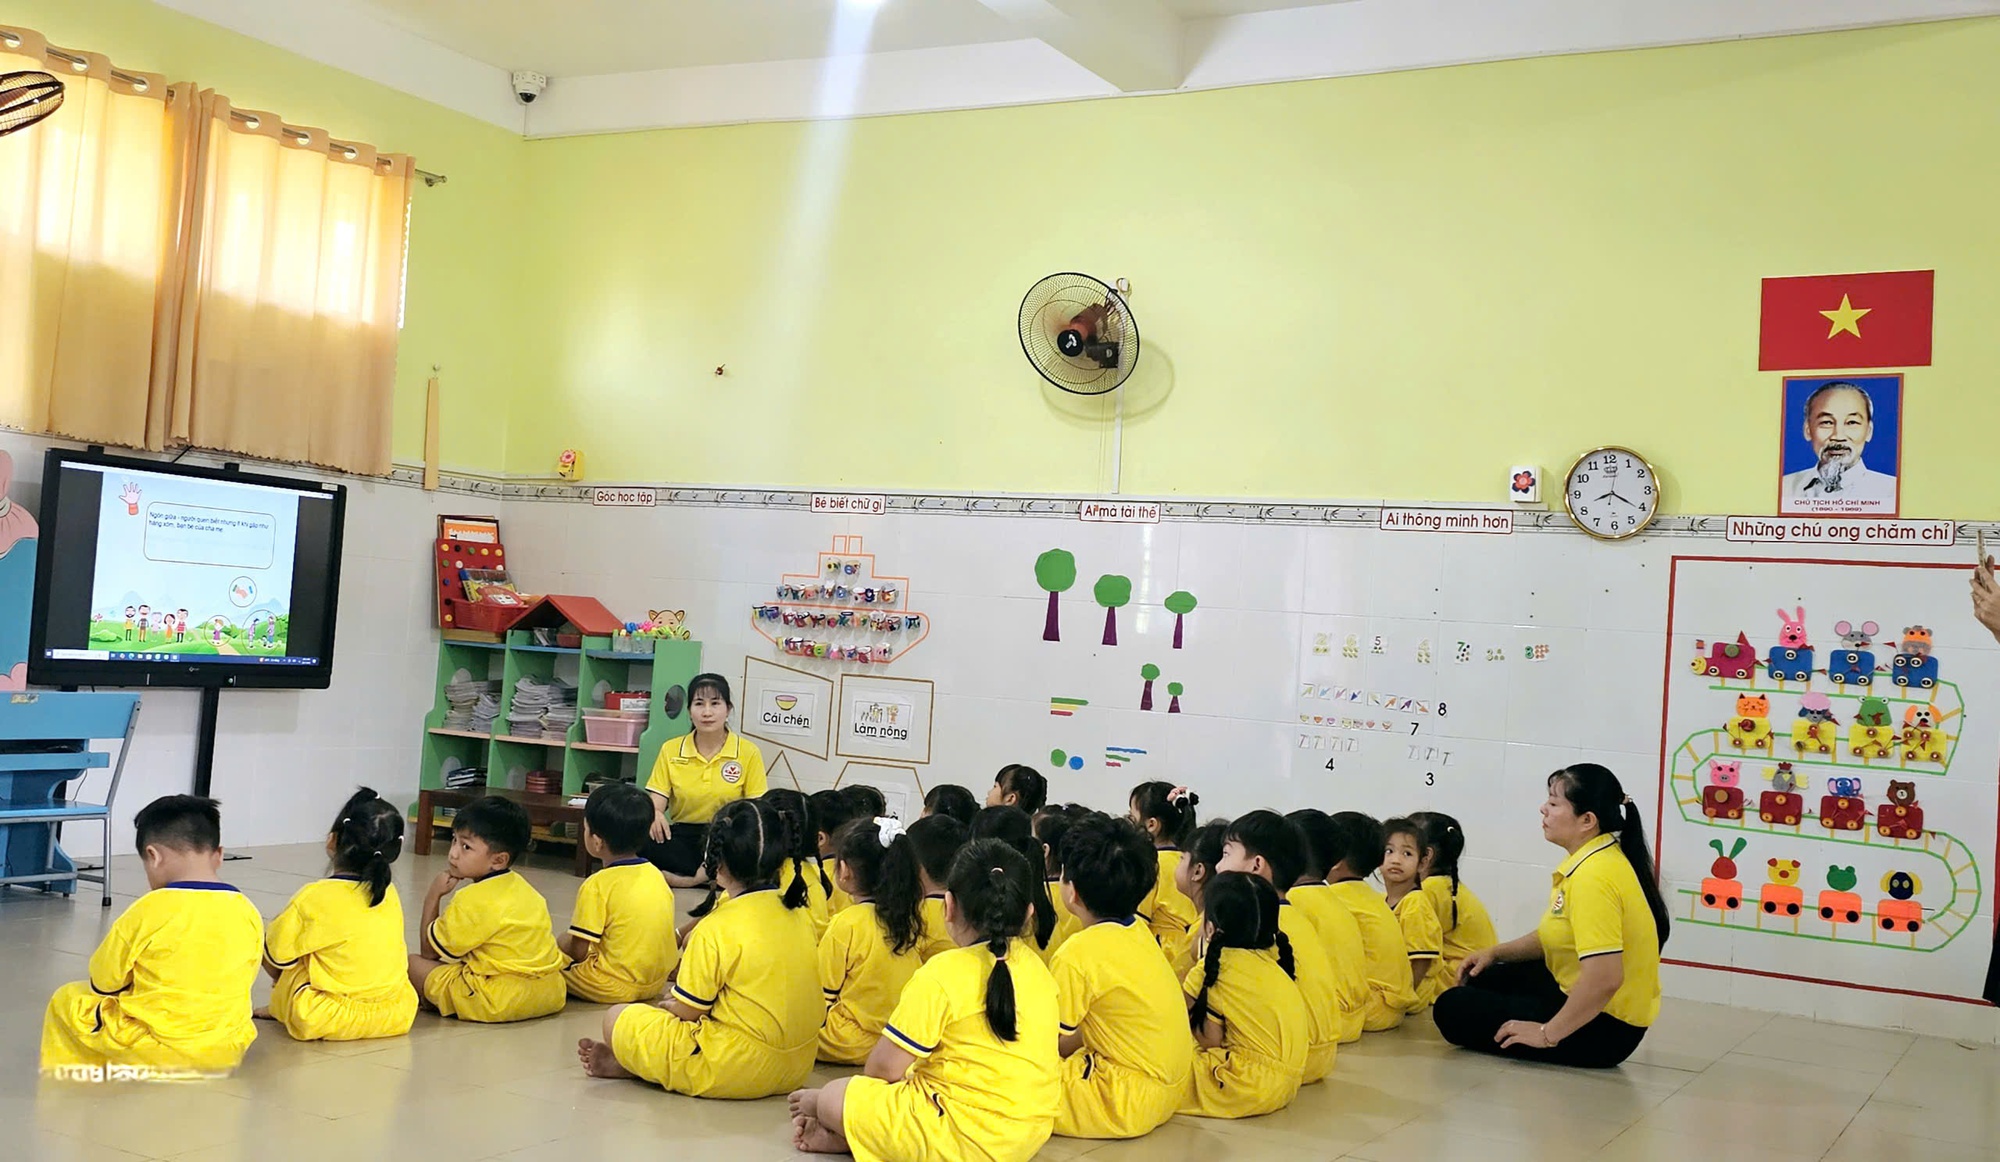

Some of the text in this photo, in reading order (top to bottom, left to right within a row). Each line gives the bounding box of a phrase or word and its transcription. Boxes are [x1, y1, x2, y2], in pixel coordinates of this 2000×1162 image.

[1603, 454, 1617, 464] 12
[1625, 459, 1632, 468] 1
[1588, 461, 1599, 471] 11
[1577, 474, 1589, 483] 10
[1637, 469, 1645, 478] 2
[1573, 490, 1581, 499] 9
[1644, 485, 1652, 495] 3
[597, 490, 653, 504] Góc học tập
[815, 496, 827, 508] Bé
[830, 496, 848, 508] biết
[851, 497, 870, 509] chữ
[1638, 502, 1647, 511] 4
[1099, 504, 1117, 517] mà
[1121, 504, 1135, 518] tài
[1139, 504, 1158, 518] thế
[1580, 506, 1588, 515] 8
[1386, 513, 1509, 529] Ai thông minh hơn
[1593, 517, 1601, 527] 7
[1627, 515, 1636, 525] 5
[1611, 521, 1619, 531] 6
[1732, 520, 1949, 541] Những chú ong chăm chỉ
[1374, 636, 1381, 646] 5
[1457, 641, 1465, 651] 7
[1437, 702, 1447, 716] 8
[763, 711, 809, 727] Cái chén
[854, 722, 908, 740] Làm nông
[1410, 722, 1419, 735] 7
[1325, 757, 1335, 771] 4
[1425, 772, 1435, 786] 3
